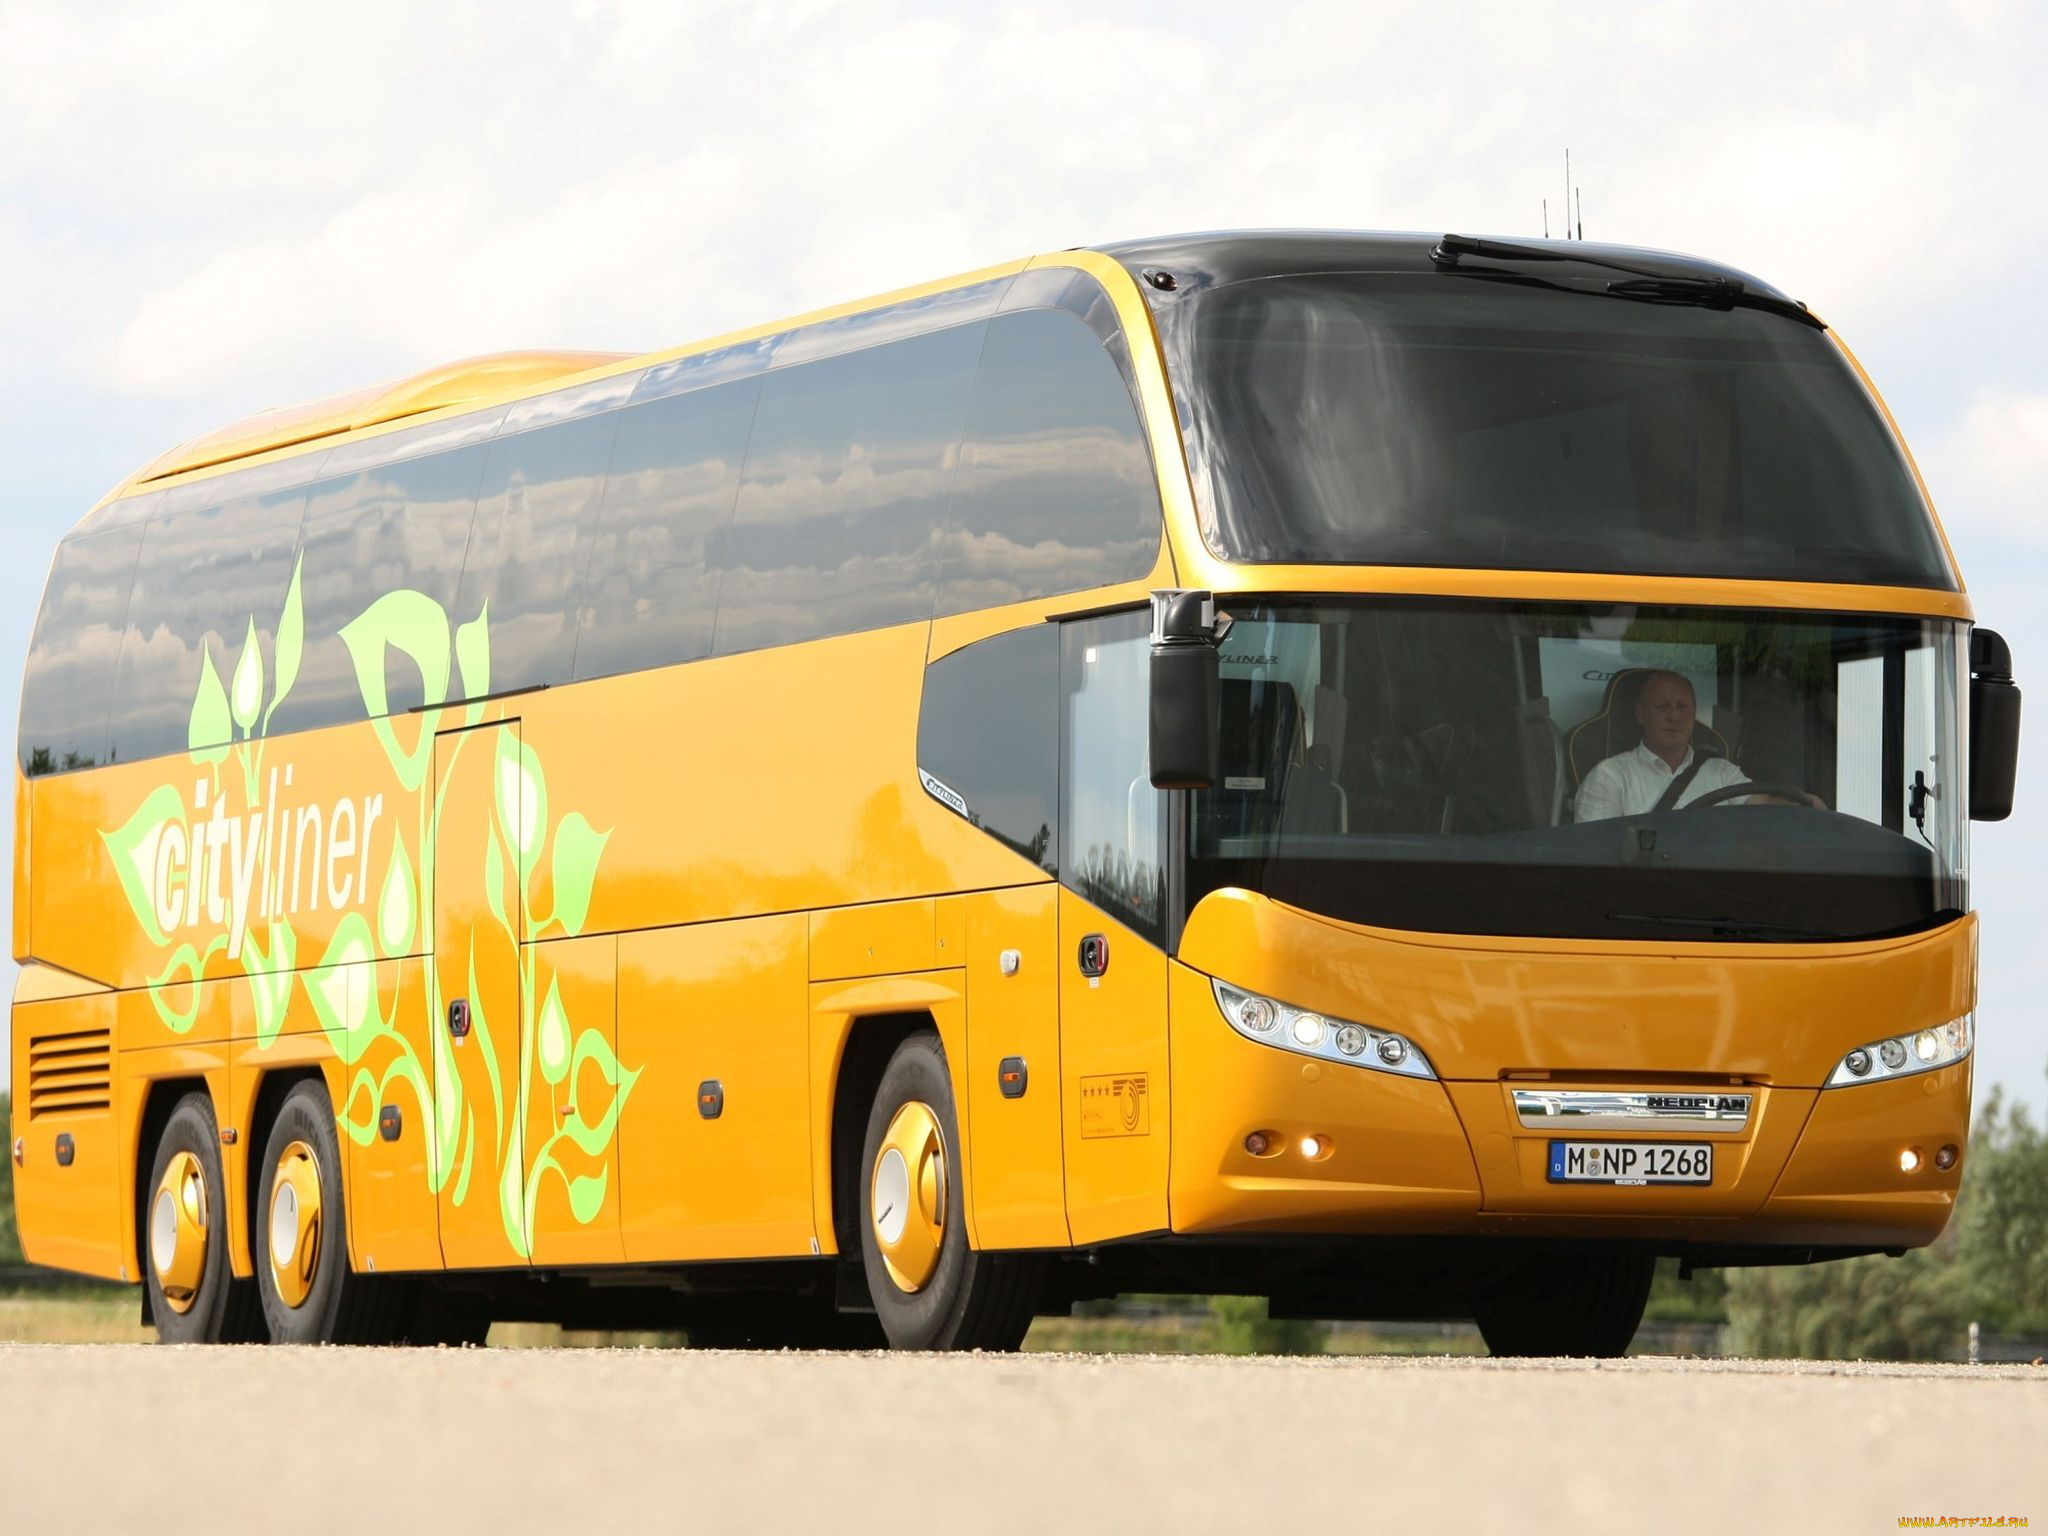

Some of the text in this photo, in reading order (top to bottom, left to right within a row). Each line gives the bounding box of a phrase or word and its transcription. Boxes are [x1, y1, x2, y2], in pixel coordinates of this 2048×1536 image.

[155, 764, 383, 959] cityliner
[1648, 1097, 1746, 1111] NEOPLAN
[1568, 1148, 1708, 1176] M NP 1268
